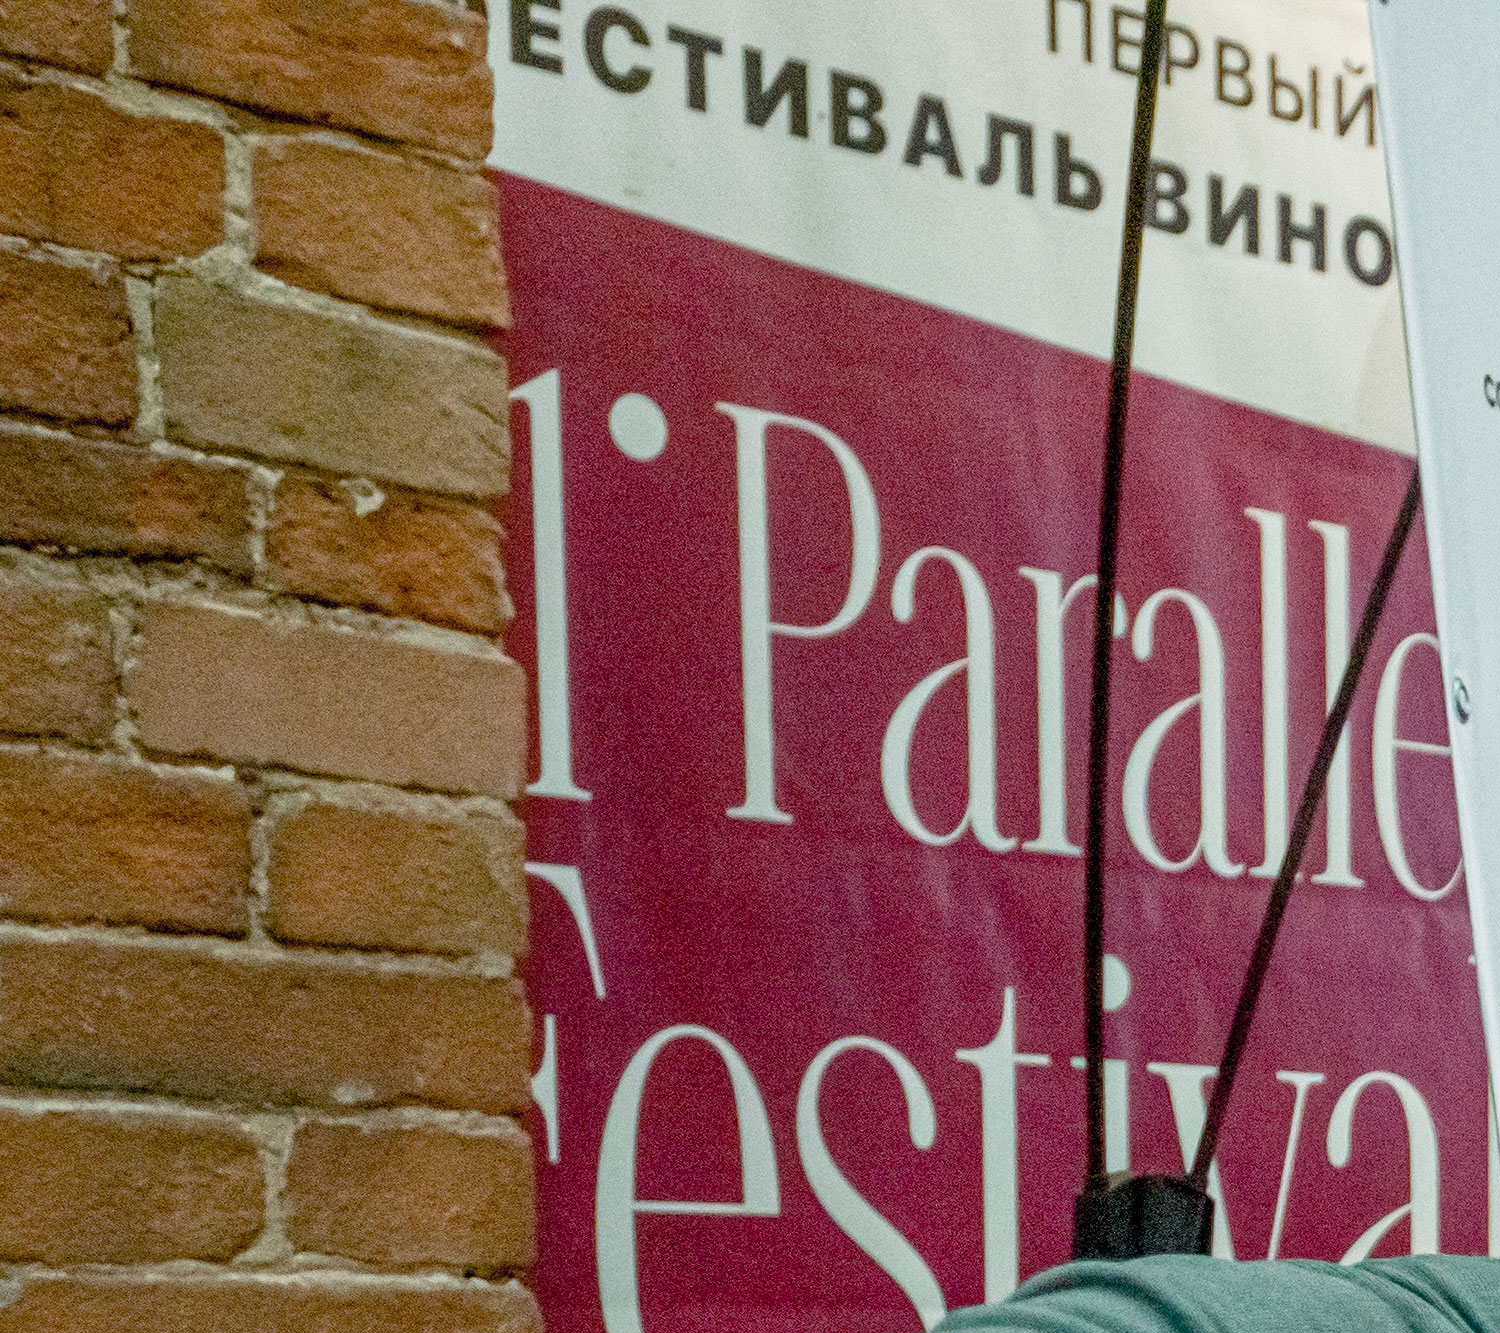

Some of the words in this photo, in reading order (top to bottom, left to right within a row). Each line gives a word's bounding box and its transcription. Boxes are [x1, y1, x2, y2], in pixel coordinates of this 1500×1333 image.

[509, 0, 1104, 212] ЕСТИВАЛЬ
[1144, 157, 1393, 288] ВИНО
[1047, 0, 1377, 148] ПЕРВЫЙ
[715, 401, 1465, 901] Paralle
